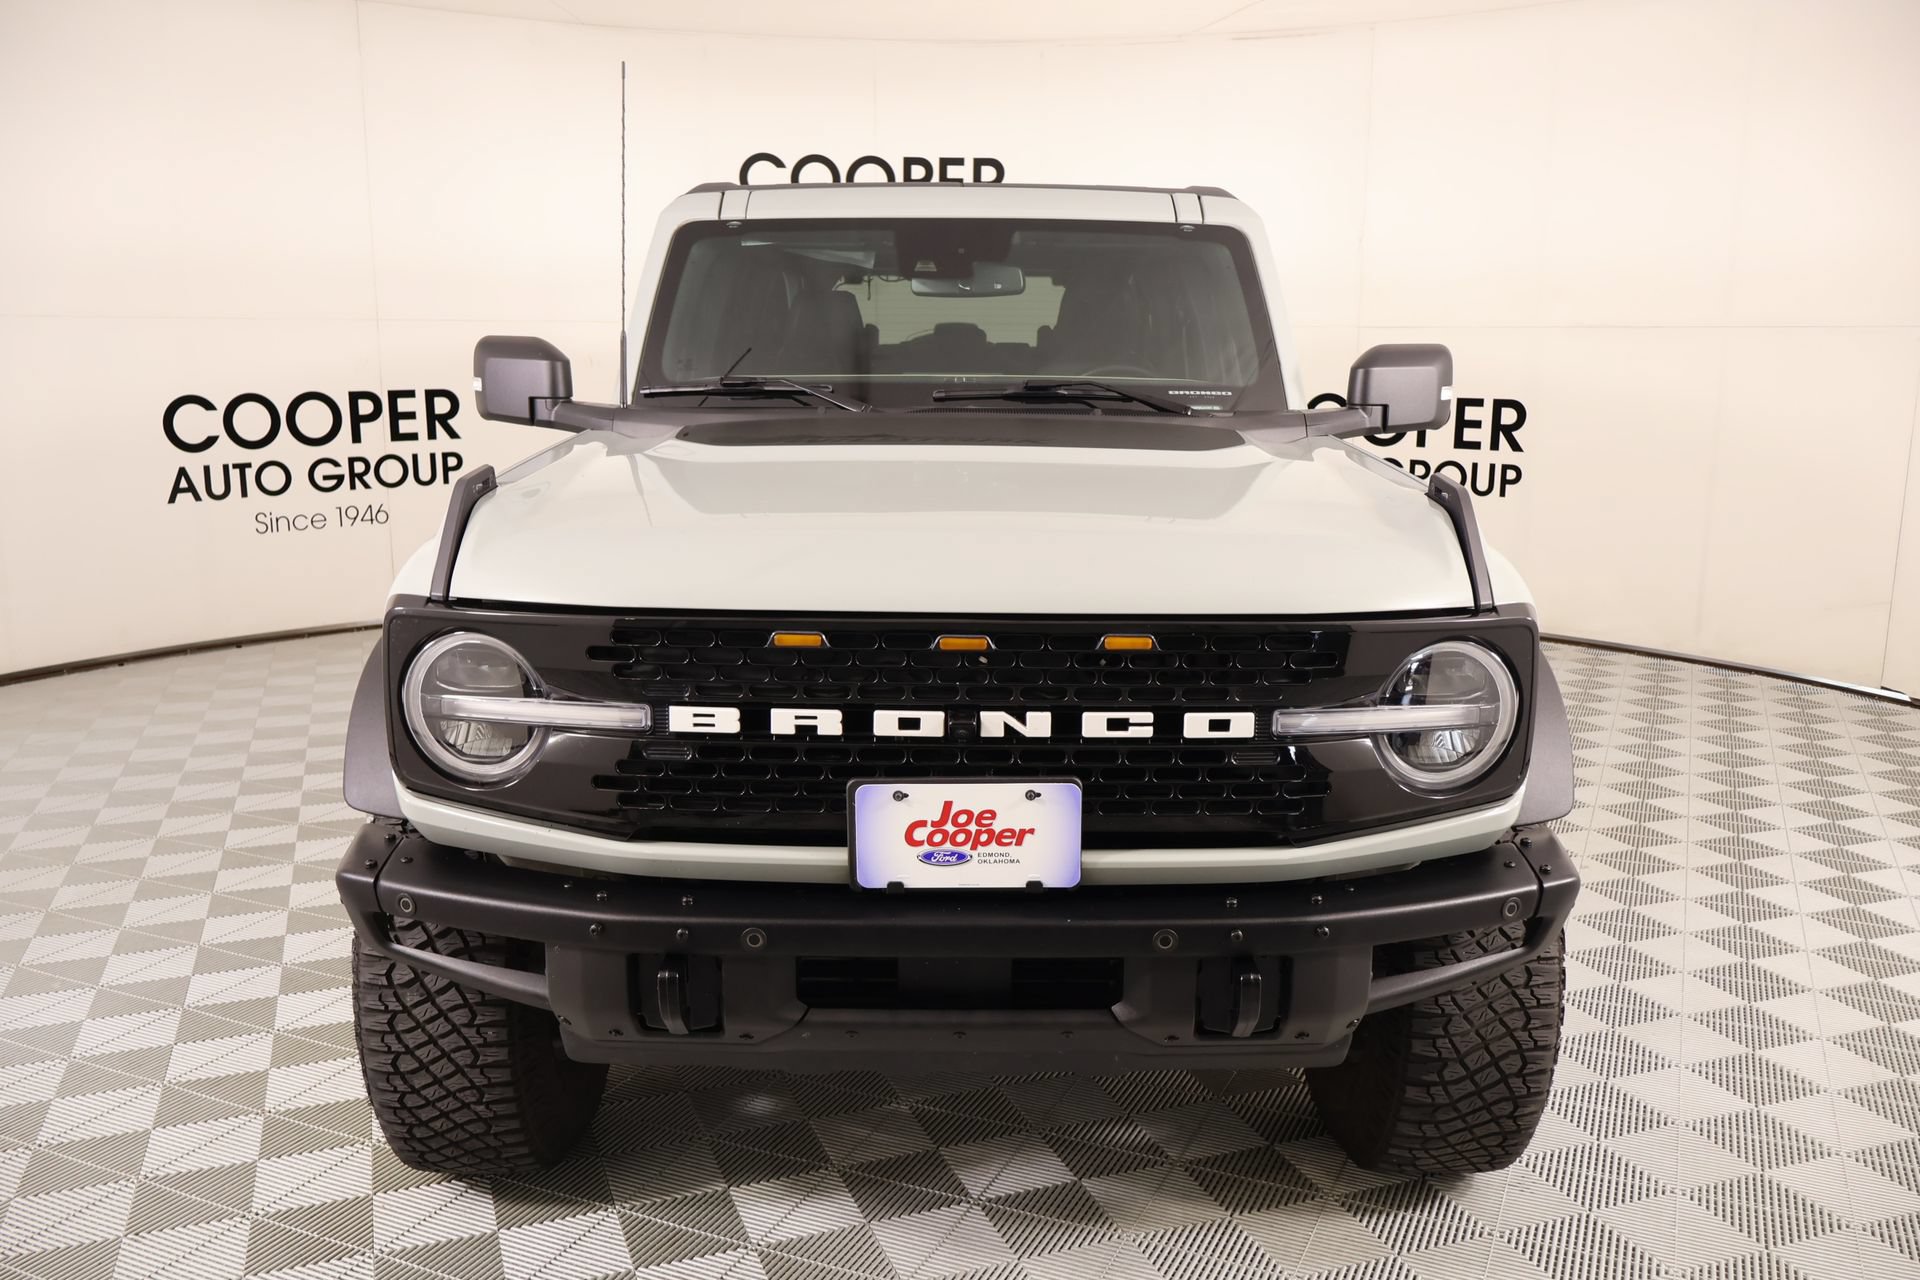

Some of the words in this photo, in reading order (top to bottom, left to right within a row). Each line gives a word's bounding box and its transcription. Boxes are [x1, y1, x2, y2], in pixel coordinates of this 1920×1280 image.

[162, 388, 461, 453] COOPER
[167, 460, 292, 504] AUTO
[308, 451, 463, 493] GROUP
[1382, 457, 1522, 498] ROUP
[255, 511, 327, 534] Since
[335, 504, 389, 527] 1946
[669, 705, 1255, 738] BRONCO
[931, 800, 997, 828] Joe
[904, 820, 1035, 851] Cooper
[931, 850, 958, 863] Ford
